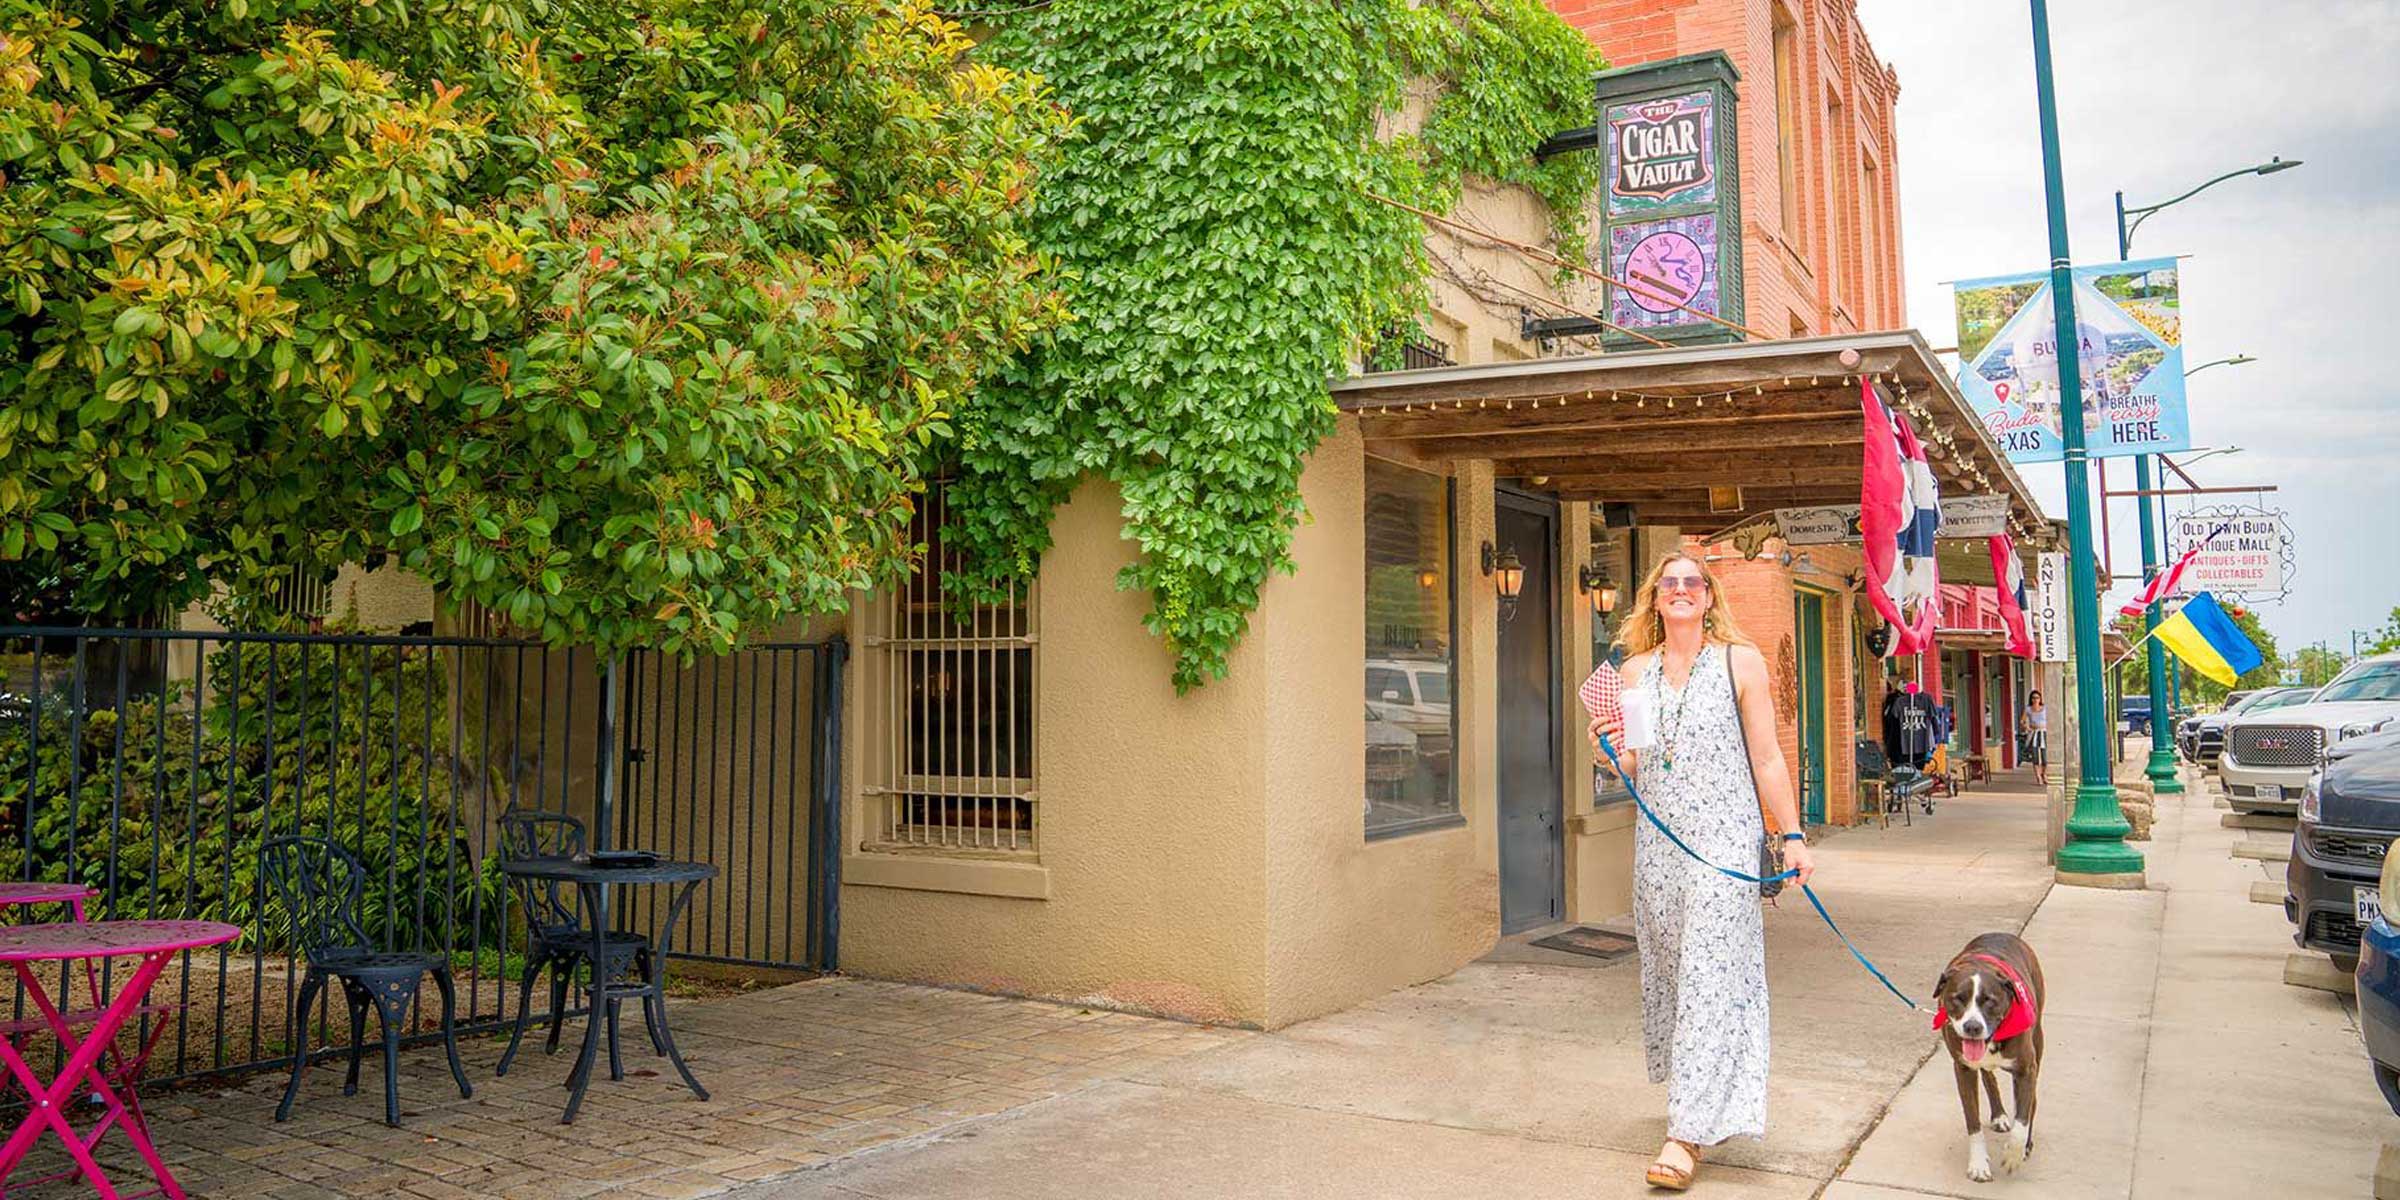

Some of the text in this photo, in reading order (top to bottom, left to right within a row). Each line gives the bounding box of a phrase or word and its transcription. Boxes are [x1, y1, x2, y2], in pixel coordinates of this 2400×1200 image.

[1644, 104, 1675, 117] THE
[1622, 119, 1700, 163] CIGAR
[1623, 160, 1696, 190] VAULT
[2033, 337, 2092, 356] BUA
[2110, 394, 2157, 409] BREATHE
[1983, 409, 2042, 436] Buda
[2111, 403, 2160, 426] easy
[1996, 430, 2040, 451] EXAS
[2183, 520, 2275, 535] OLD TOWN BUDA
[2188, 538, 2271, 552] ANTIQUE MALL
[2190, 555, 2269, 566] ANTIQUES GIFTS
[2196, 569, 2264, 579] COLLECTABLES
[2042, 556, 2055, 659] ANTIQUES
